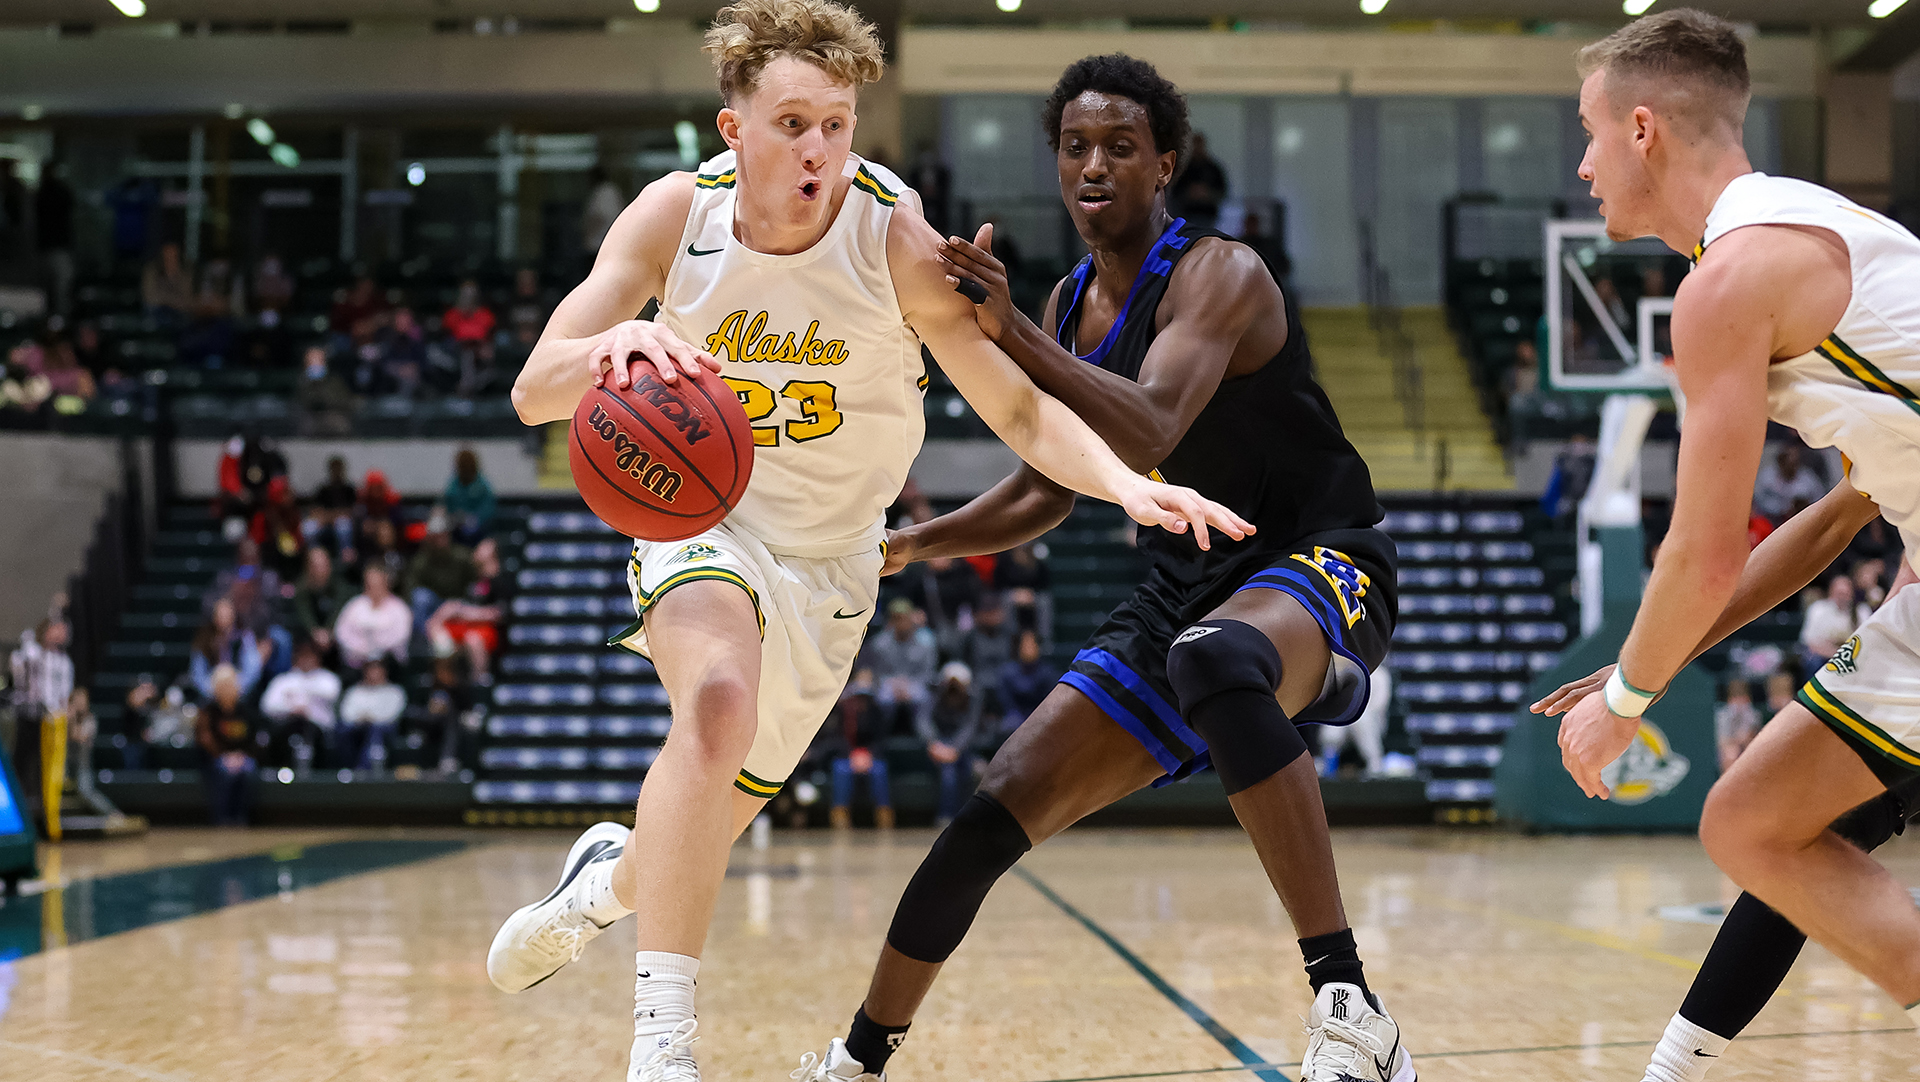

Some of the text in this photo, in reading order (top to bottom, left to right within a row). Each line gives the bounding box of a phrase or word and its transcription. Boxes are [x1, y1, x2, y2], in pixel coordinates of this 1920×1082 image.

[703, 309, 850, 367] Alaska
[632, 374, 711, 446] NCAA
[720, 375, 844, 447] 23
[587, 401, 684, 504] Wilson
